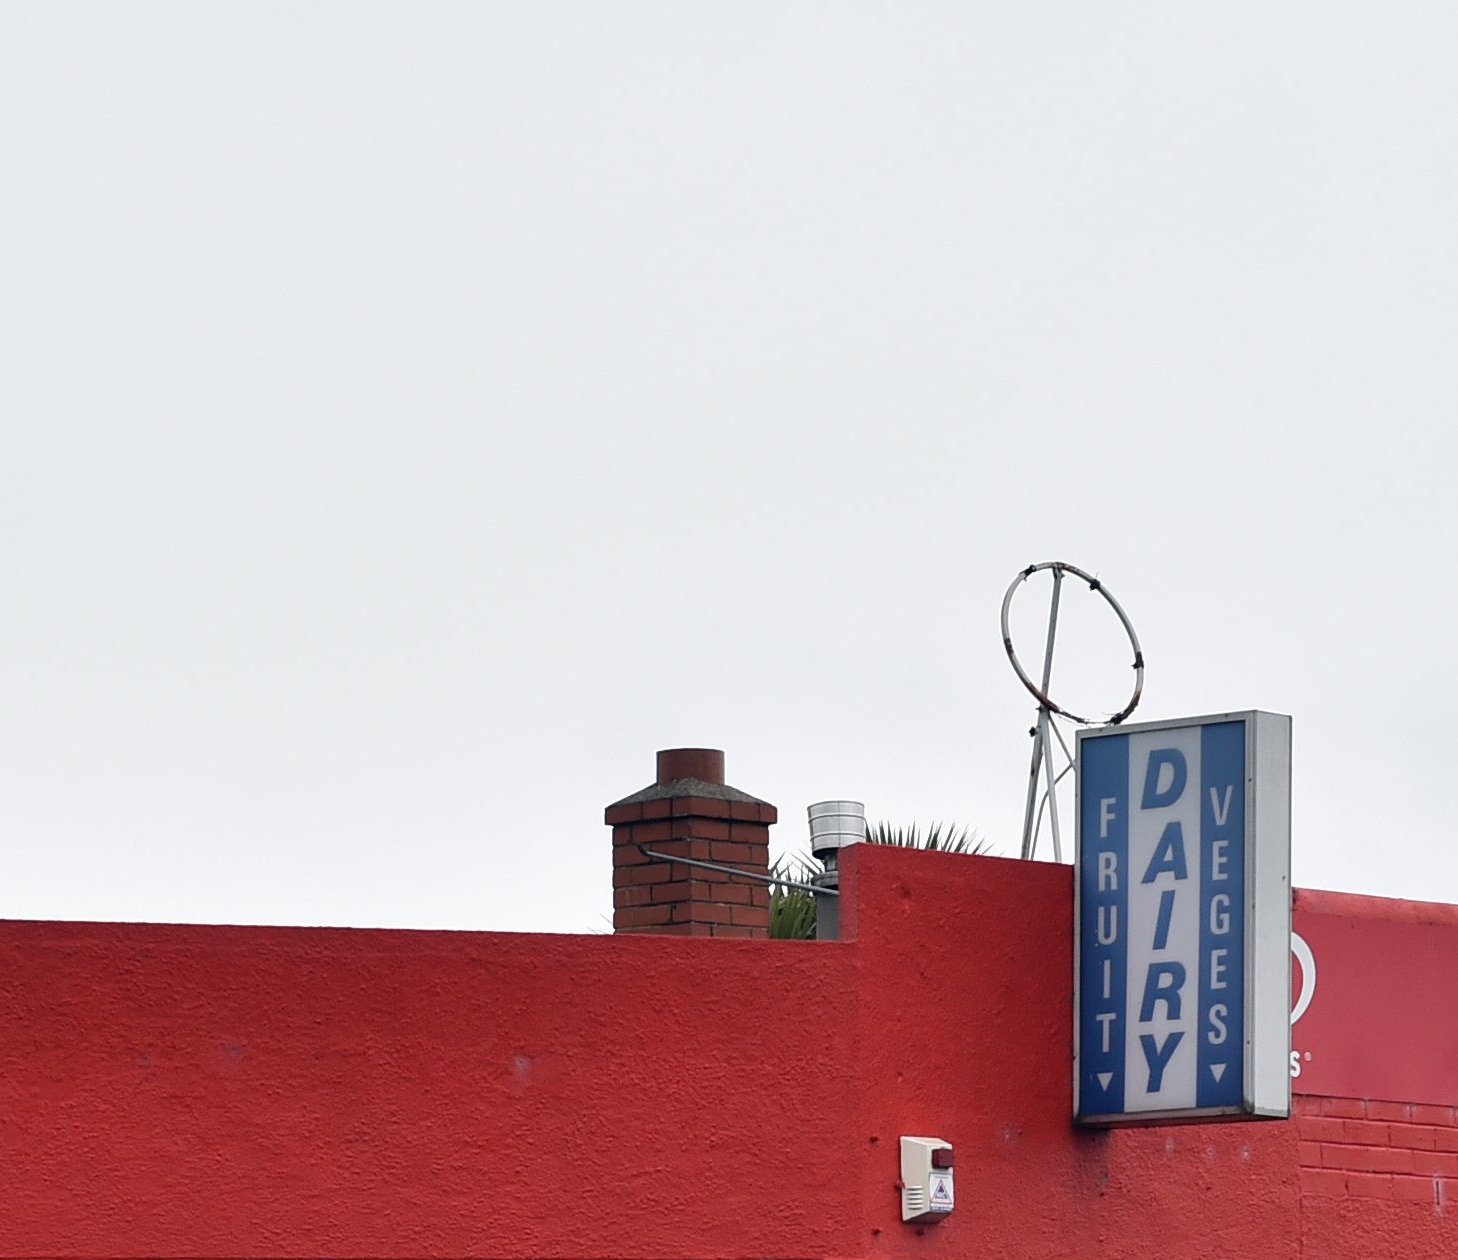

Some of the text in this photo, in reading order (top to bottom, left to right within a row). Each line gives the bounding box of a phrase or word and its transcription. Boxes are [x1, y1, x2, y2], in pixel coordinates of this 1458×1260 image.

[1096, 797, 1118, 1053] FRUIT
[1139, 747, 1189, 1093] DAIRY
[1208, 784, 1233, 1046] VEGES
